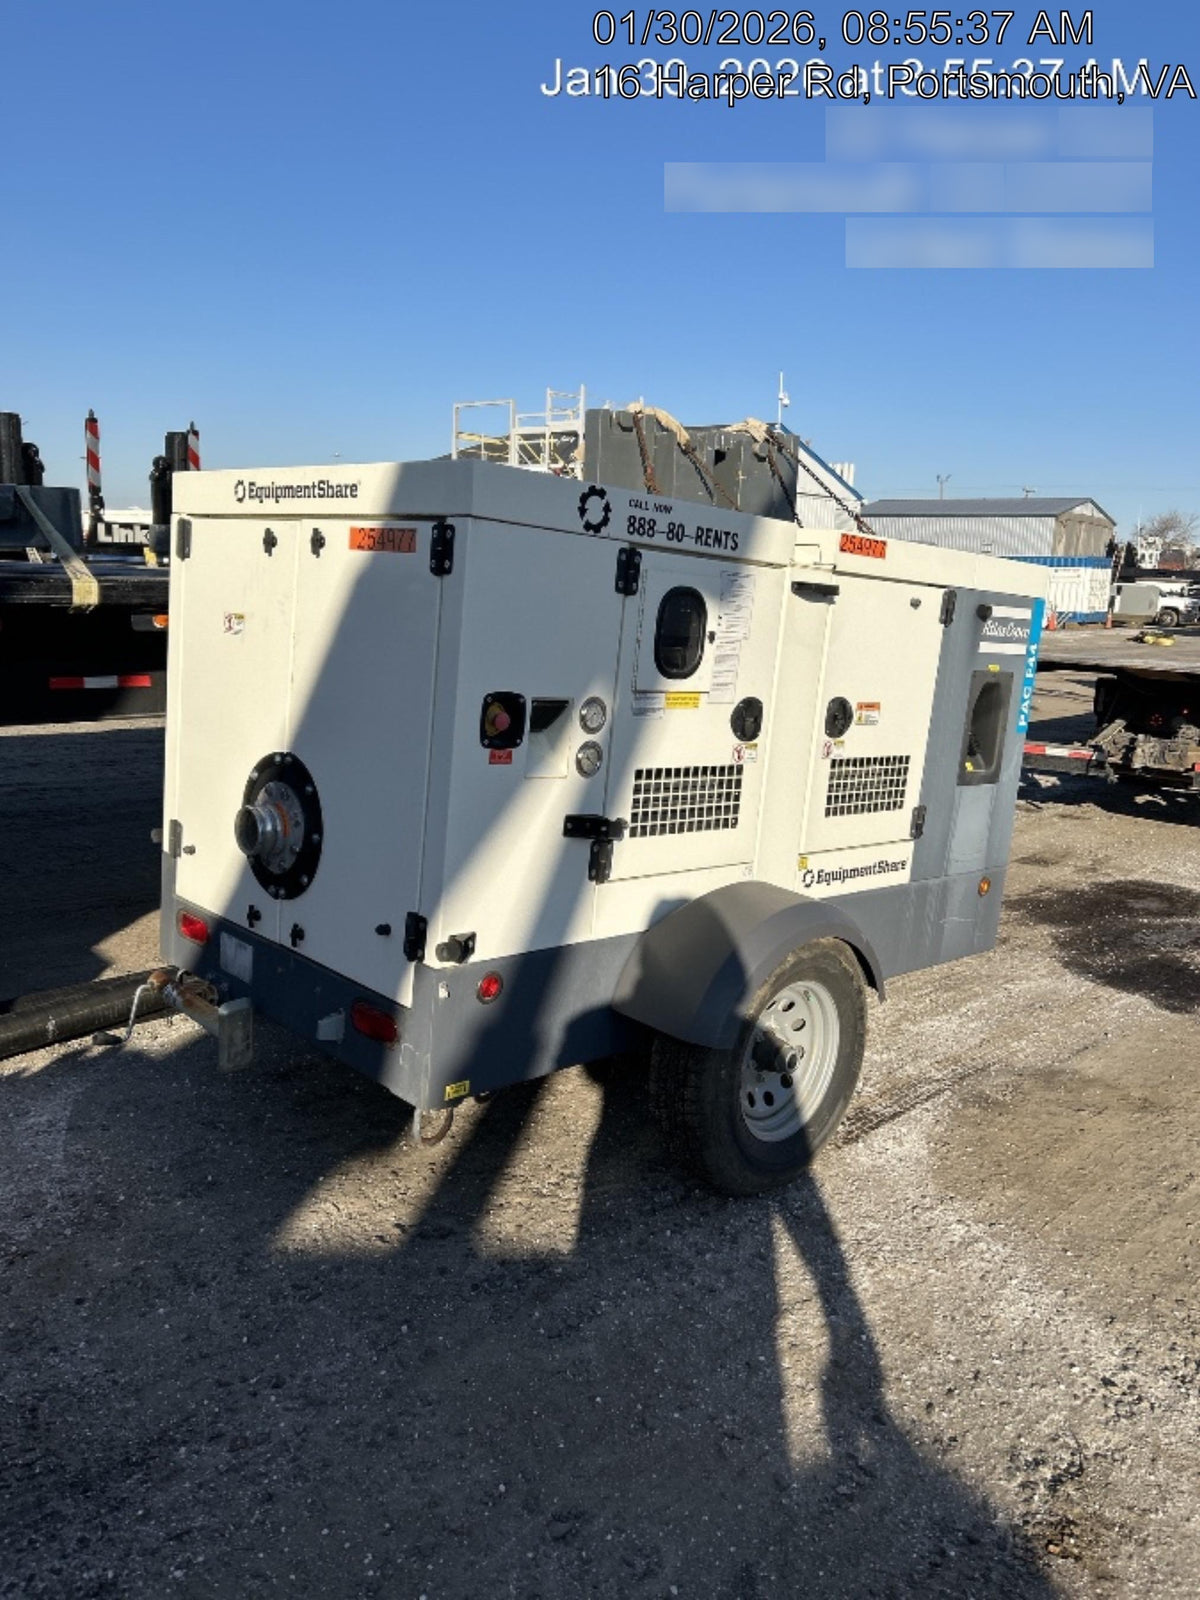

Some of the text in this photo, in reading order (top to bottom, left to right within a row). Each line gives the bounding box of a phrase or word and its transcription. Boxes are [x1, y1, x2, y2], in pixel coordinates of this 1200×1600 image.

[247, 480, 359, 503] EquipmentShare
[628, 499, 673, 515] CALL NOW
[355, 527, 417, 551] 254977
[627, 515, 738, 551] 888-80-RENTS
[815, 860, 907, 886] EquipmentShare
